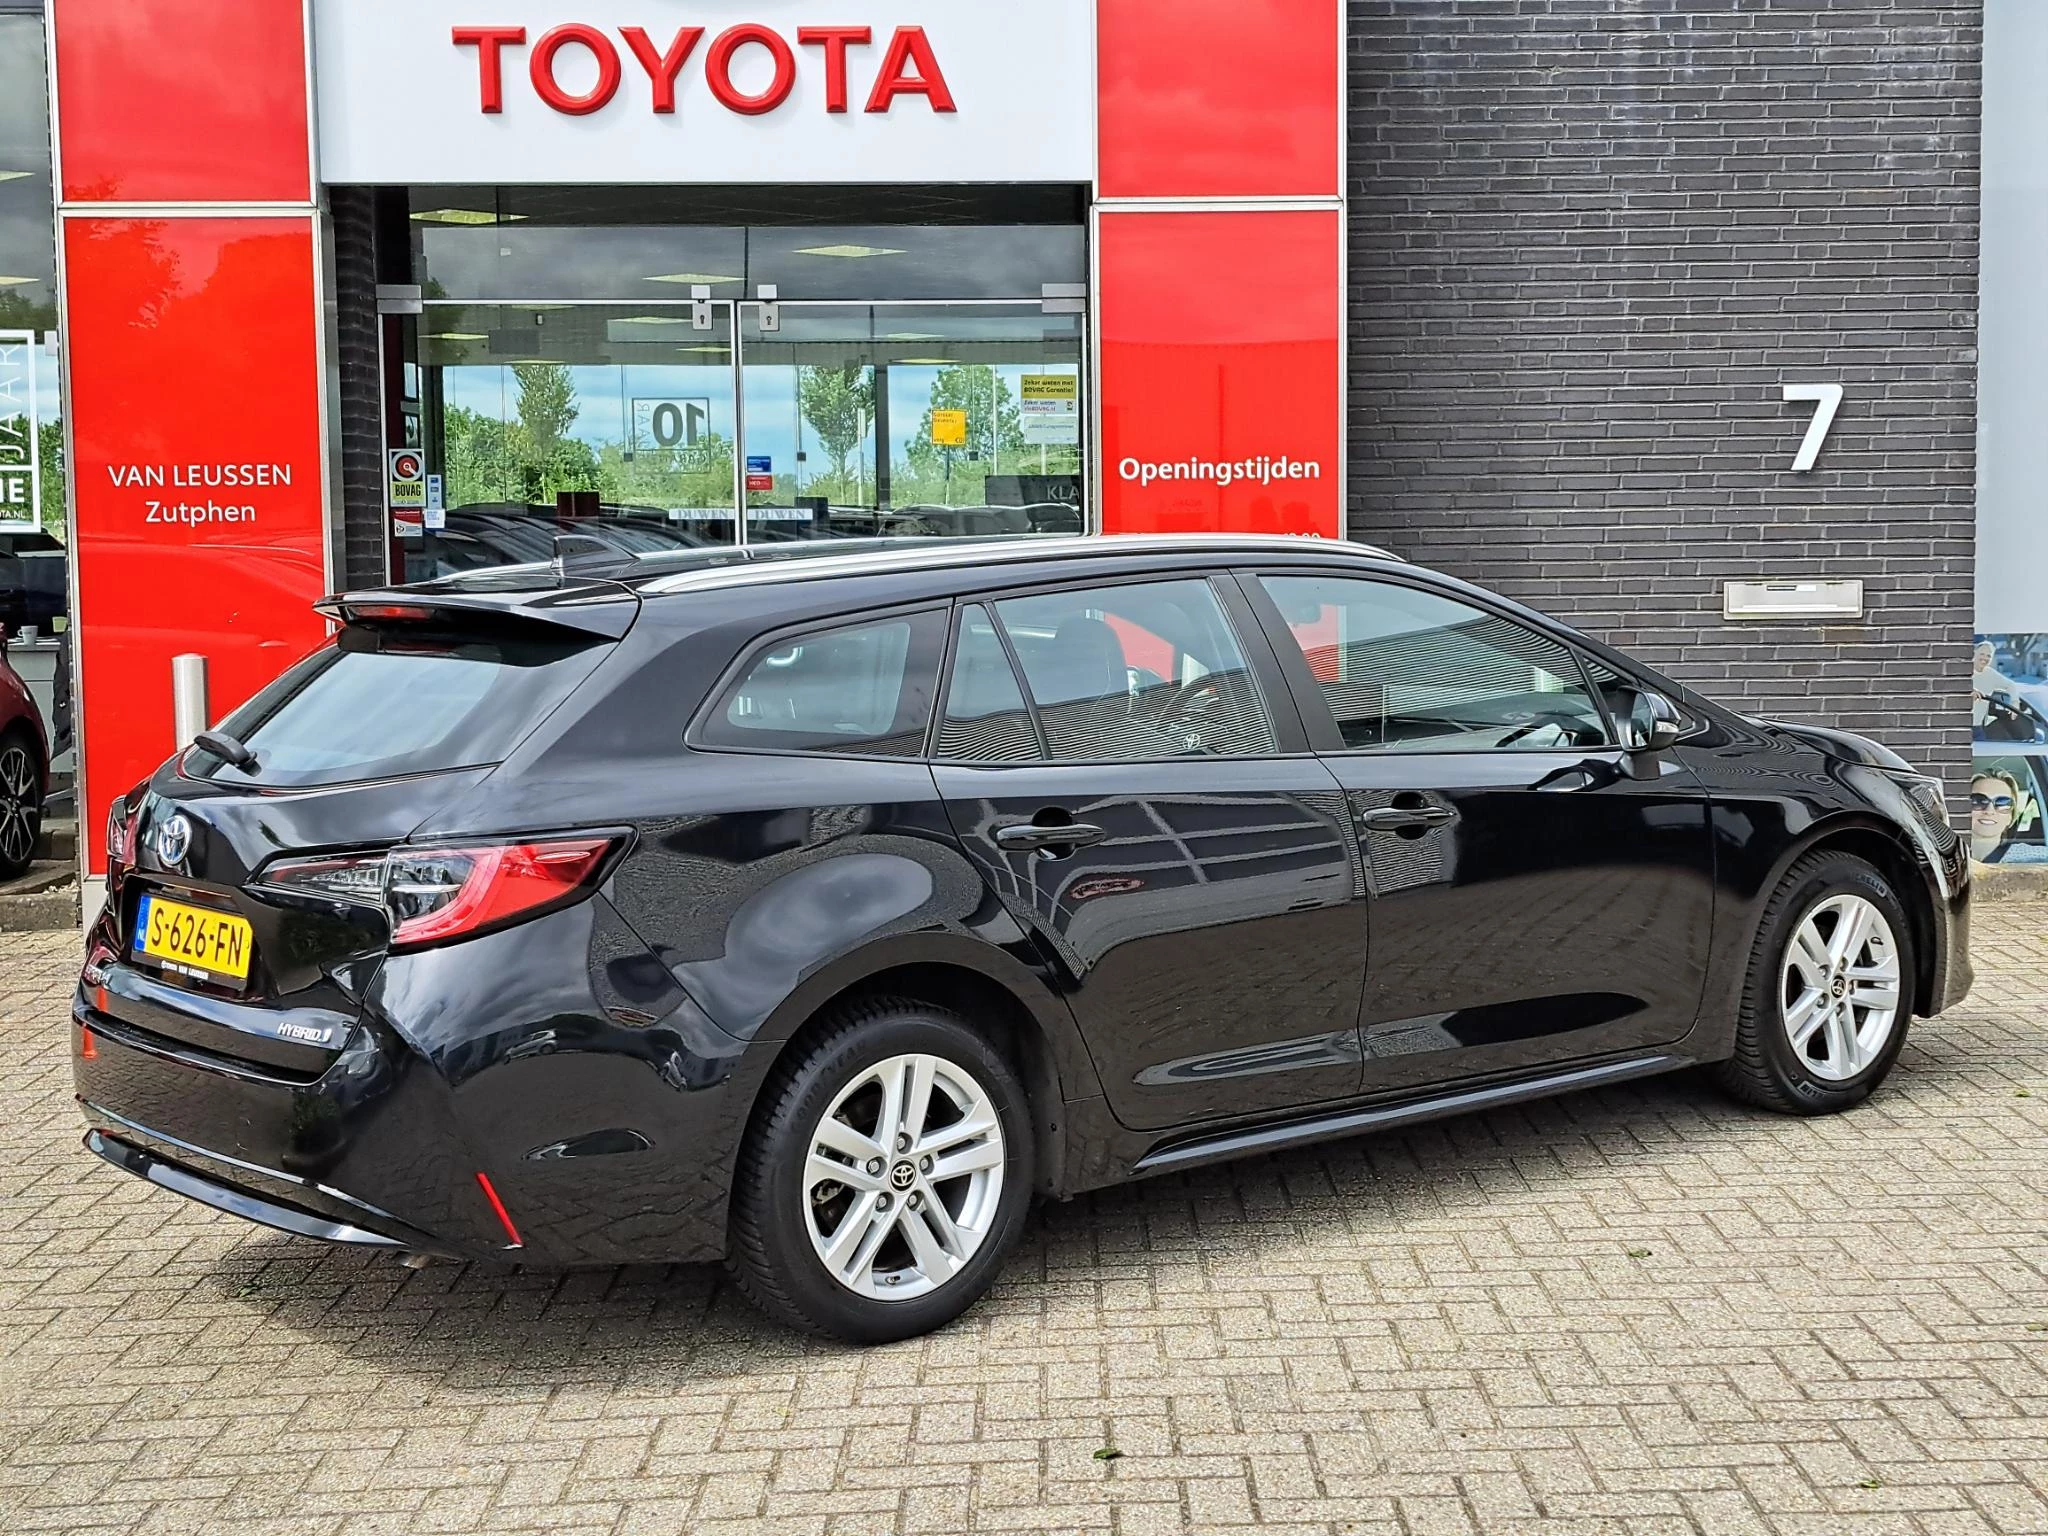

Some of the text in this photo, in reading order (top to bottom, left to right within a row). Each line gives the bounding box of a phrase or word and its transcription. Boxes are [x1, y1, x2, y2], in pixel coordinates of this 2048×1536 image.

[452, 24, 956, 115] TOYOTA
[1782, 384, 1844, 471] 7
[108, 464, 291, 487] VAN LEUSSEN
[1119, 456, 1320, 487] Openingstijden
[394, 484, 422, 497] BOVAG
[145, 499, 256, 528] Zutphen
[151, 907, 244, 967] S-626-FN
[277, 1022, 322, 1042] HYBRID
